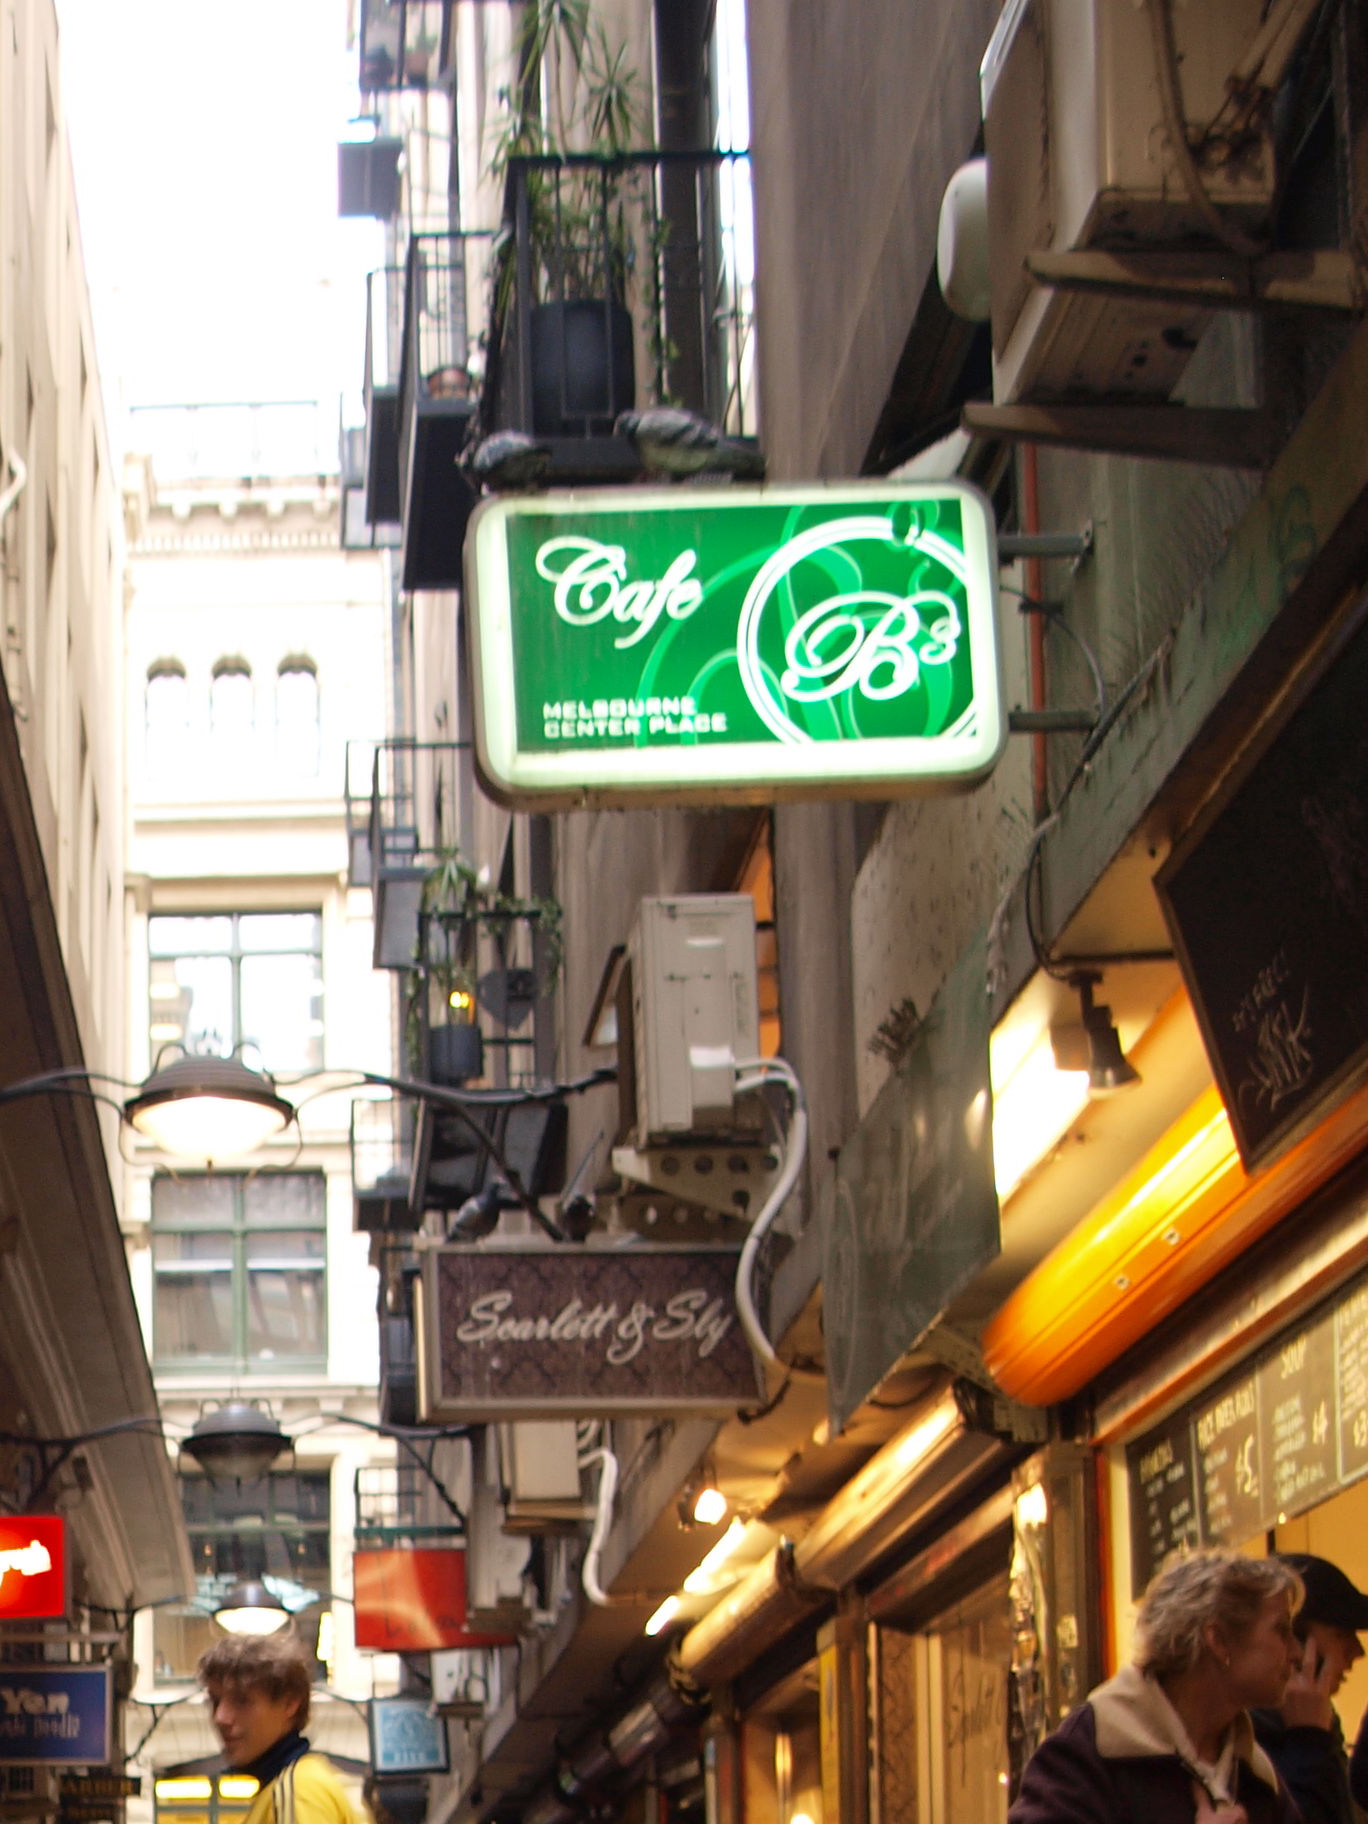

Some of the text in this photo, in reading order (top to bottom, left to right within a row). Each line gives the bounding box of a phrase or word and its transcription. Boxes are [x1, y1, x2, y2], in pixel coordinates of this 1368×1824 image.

[535, 535, 704, 649] Cafe
[543, 696, 698, 721] MELBOURNE
[544, 711, 729, 739] CENTER PLACE
[456, 1288, 732, 1365] Scarlett & Sly
